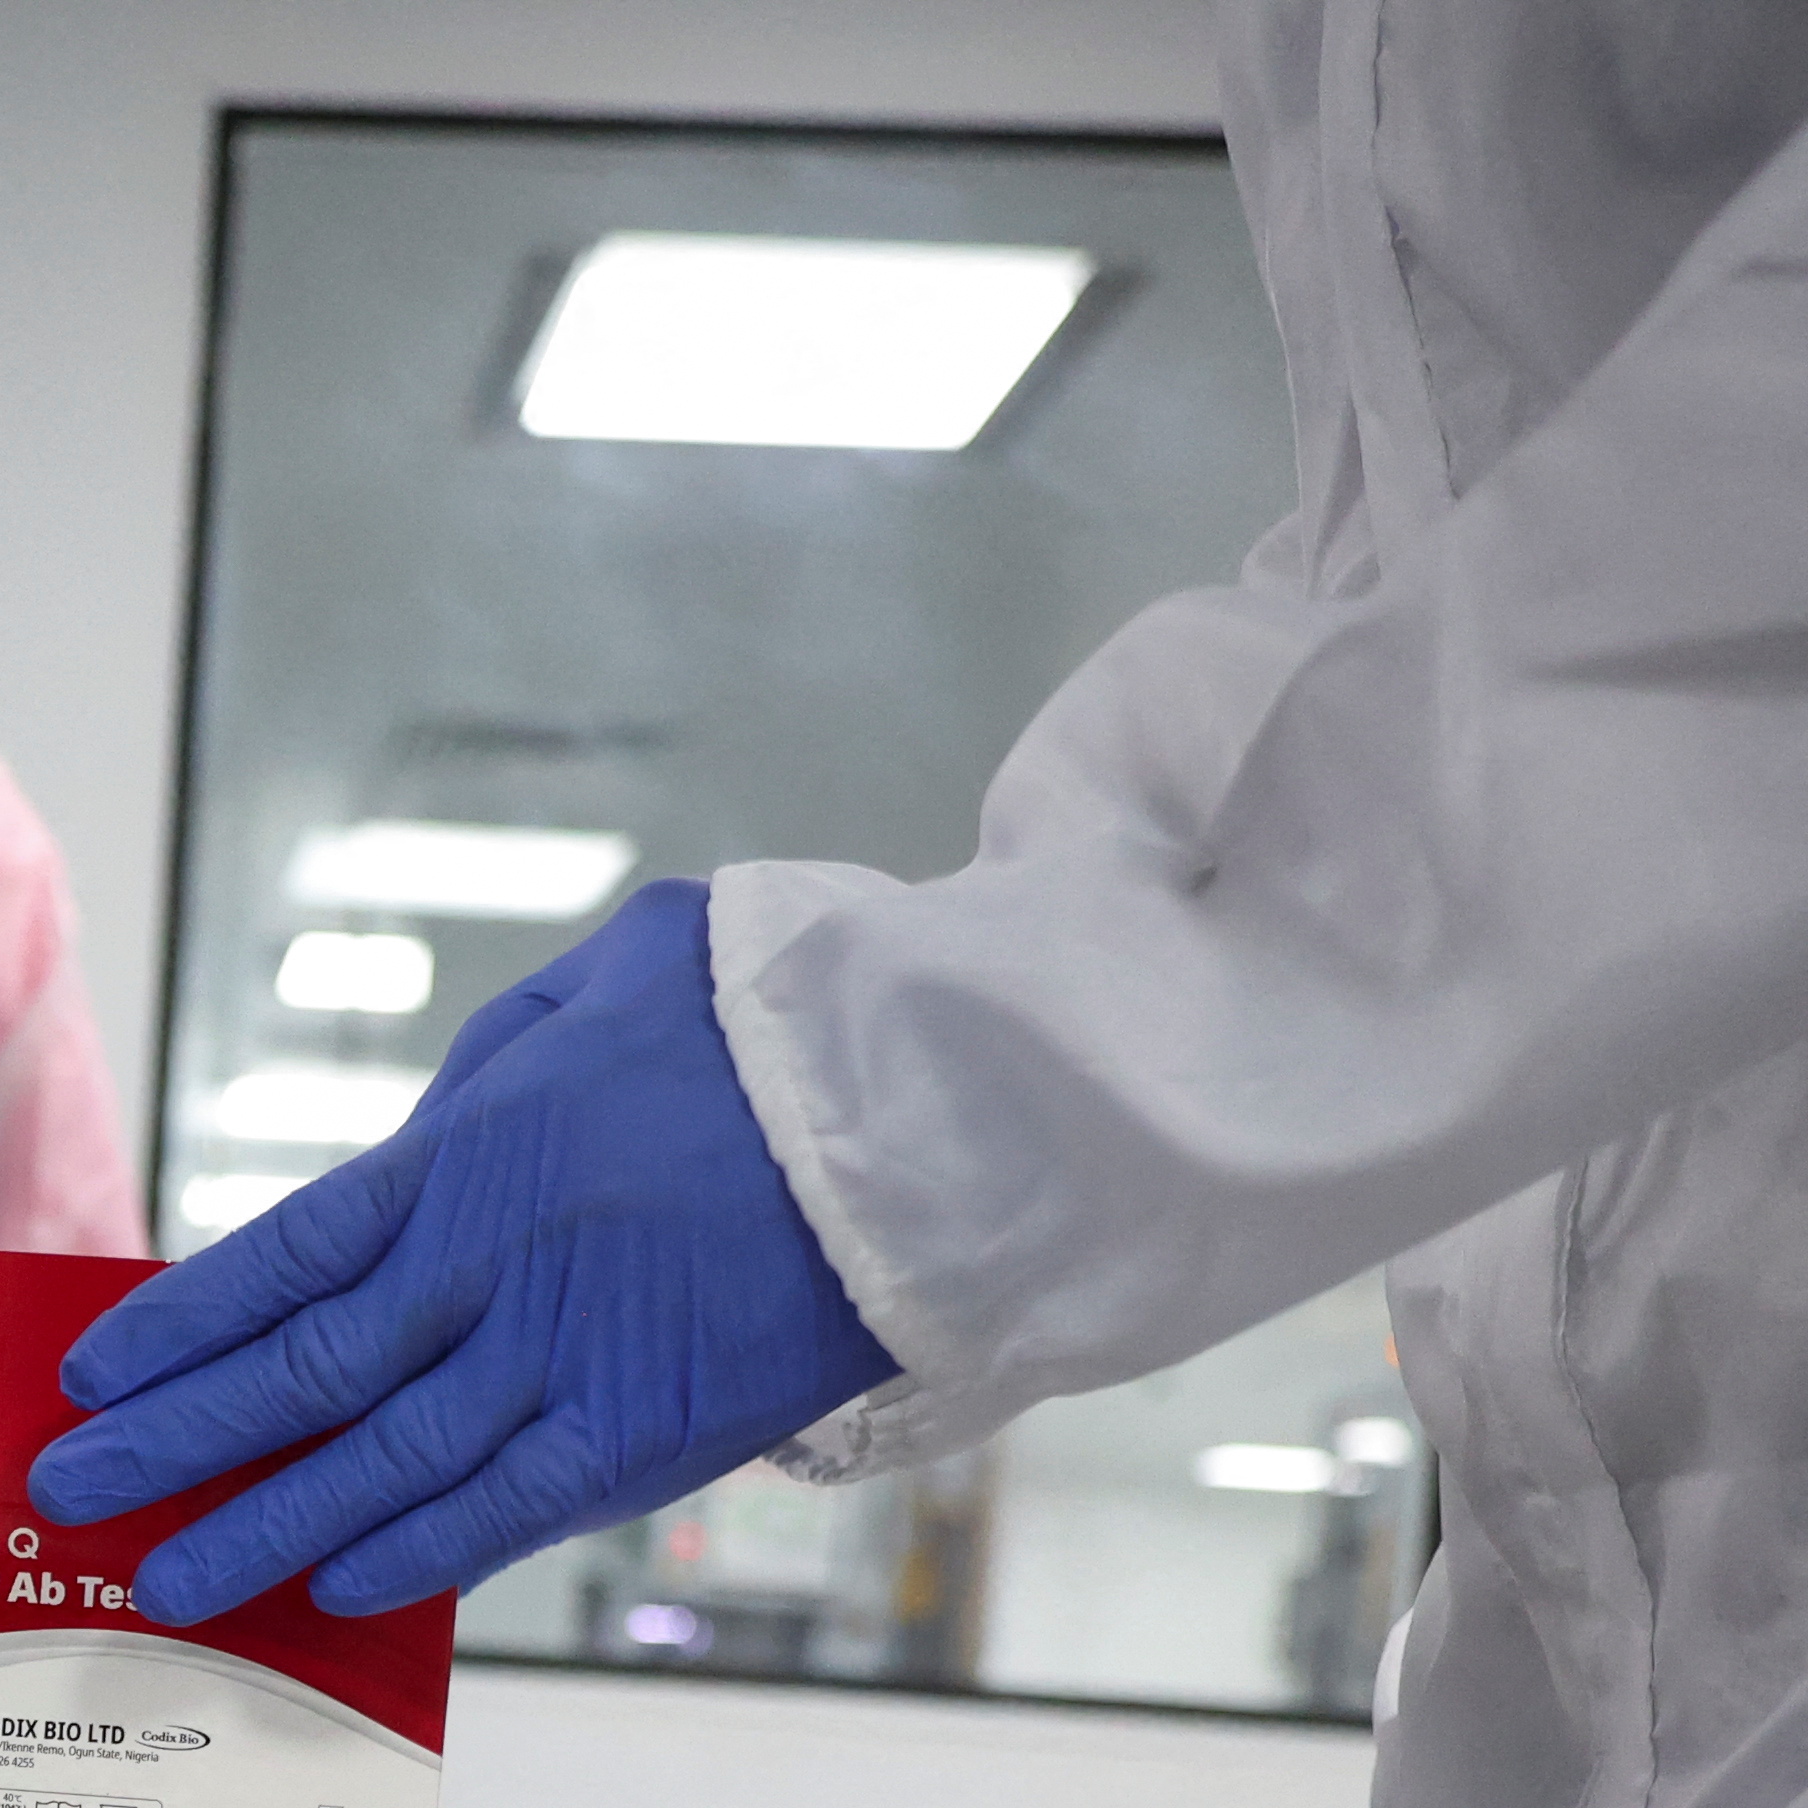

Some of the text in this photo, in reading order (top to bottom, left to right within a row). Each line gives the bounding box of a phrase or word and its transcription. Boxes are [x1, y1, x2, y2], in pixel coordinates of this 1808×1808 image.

[7, 1527, 40, 1560] Q
[7, 1571, 66, 1605] Ab
[43, 1720, 82, 1742] BIO
[88, 1723, 125, 1745] LTD
[141, 1730, 200, 1746] Codix Bio
[11, 1756, 35, 1768] 4255
[37, 1743, 66, 1757] Remo,
[69, 1745, 95, 1761] Ogun
[97, 1748, 122, 1761] State,
[125, 1751, 160, 1764] Nigeria
